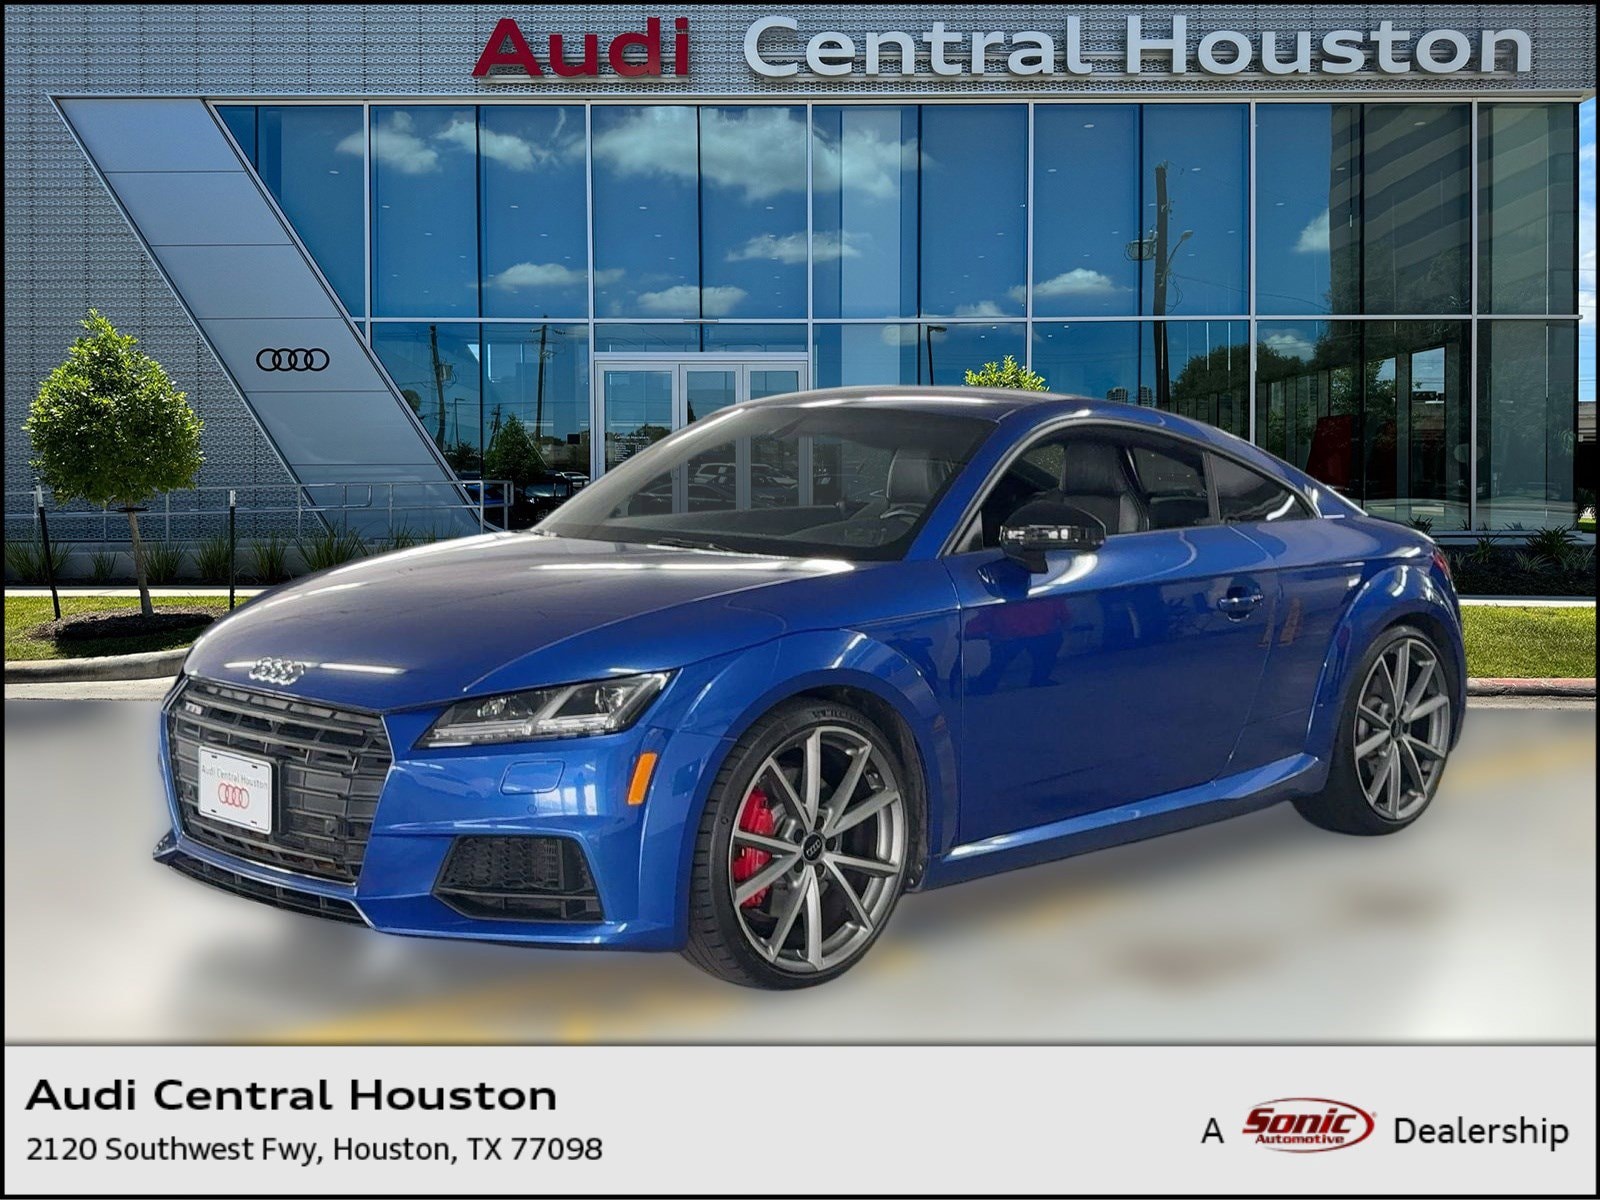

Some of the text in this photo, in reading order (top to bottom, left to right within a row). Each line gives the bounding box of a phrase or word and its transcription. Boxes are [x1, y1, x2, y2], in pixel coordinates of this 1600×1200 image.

[472, 15, 1532, 78] Audi Central Houston
[201, 763, 268, 789] Audi Central Houston
